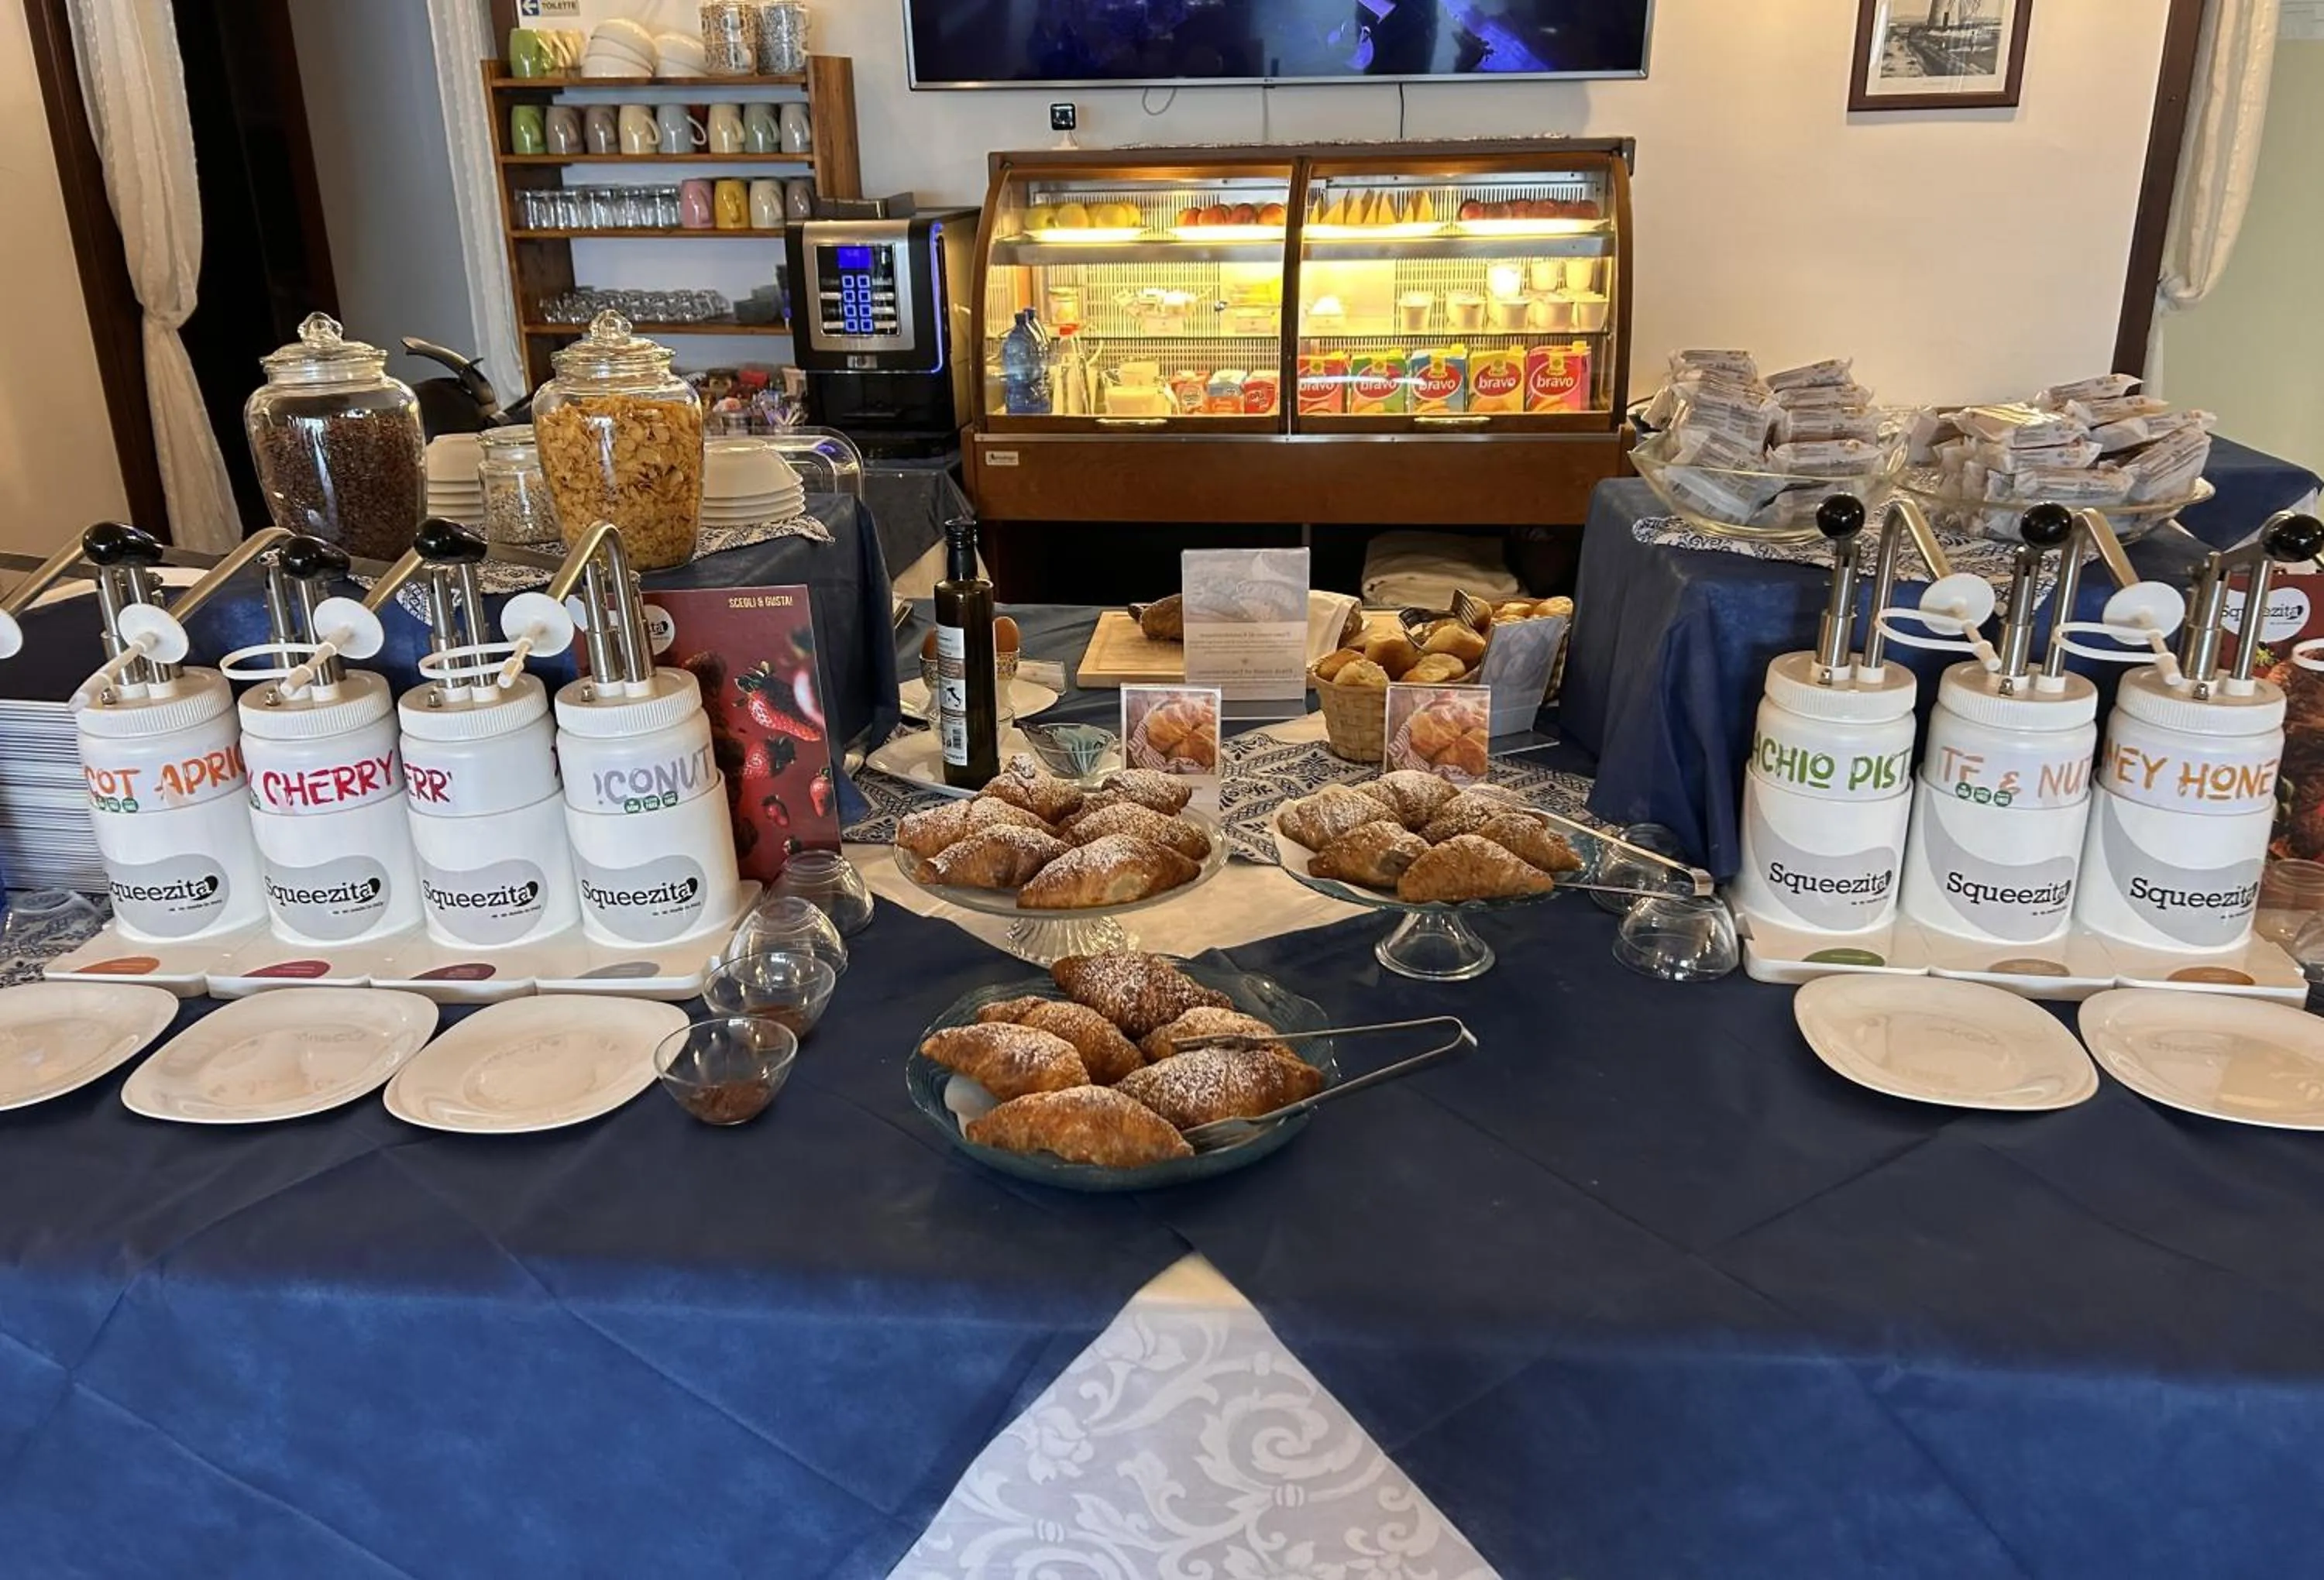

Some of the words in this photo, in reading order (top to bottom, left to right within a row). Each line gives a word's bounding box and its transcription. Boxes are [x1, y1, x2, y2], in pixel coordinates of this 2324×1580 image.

[1418, 378, 1456, 391] bravo
[1479, 376, 1516, 388] bravo
[1537, 375, 1574, 387] bravo
[263, 750, 393, 805] CHERRY
[111, 874, 218, 902] queezita
[1769, 862, 1893, 894] Squeezita
[1947, 871, 2071, 905] Squeezita
[423, 880, 538, 910] Squeezita
[582, 877, 698, 910] Squeezita
